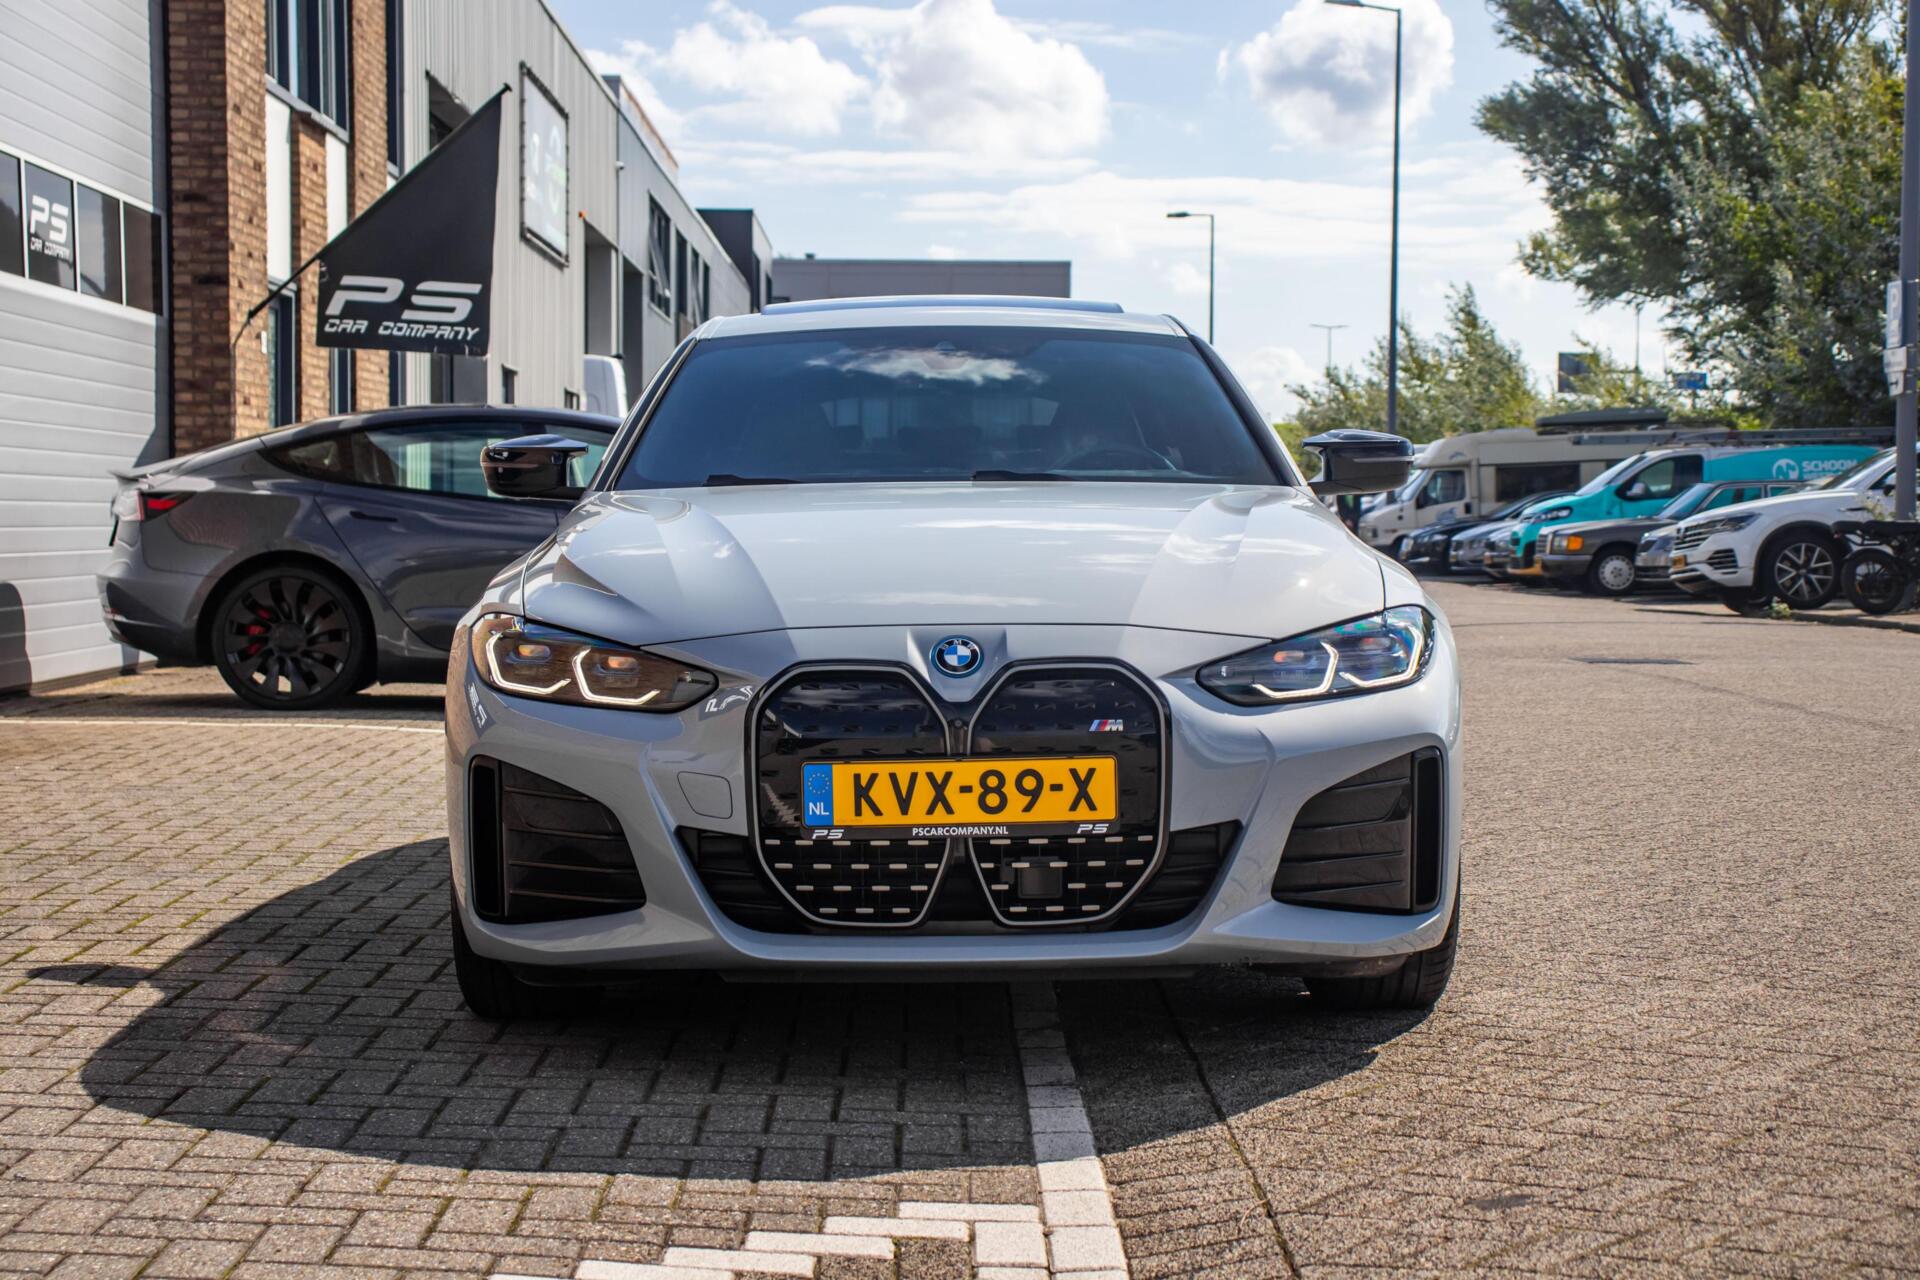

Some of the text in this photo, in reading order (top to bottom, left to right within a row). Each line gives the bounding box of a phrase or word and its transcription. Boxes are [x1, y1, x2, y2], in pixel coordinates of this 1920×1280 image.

[30, 195, 69, 244] PS
[325, 275, 482, 323] PS
[324, 319, 479, 341] CAR COMPANY
[942, 639, 977, 651] BMW
[852, 767, 1099, 817] KVX-89-X
[809, 802, 829, 816] NL
[812, 829, 844, 840] PS
[912, 824, 1009, 837] PSCARCOMPANY.NL
[1077, 823, 1109, 834] PS
